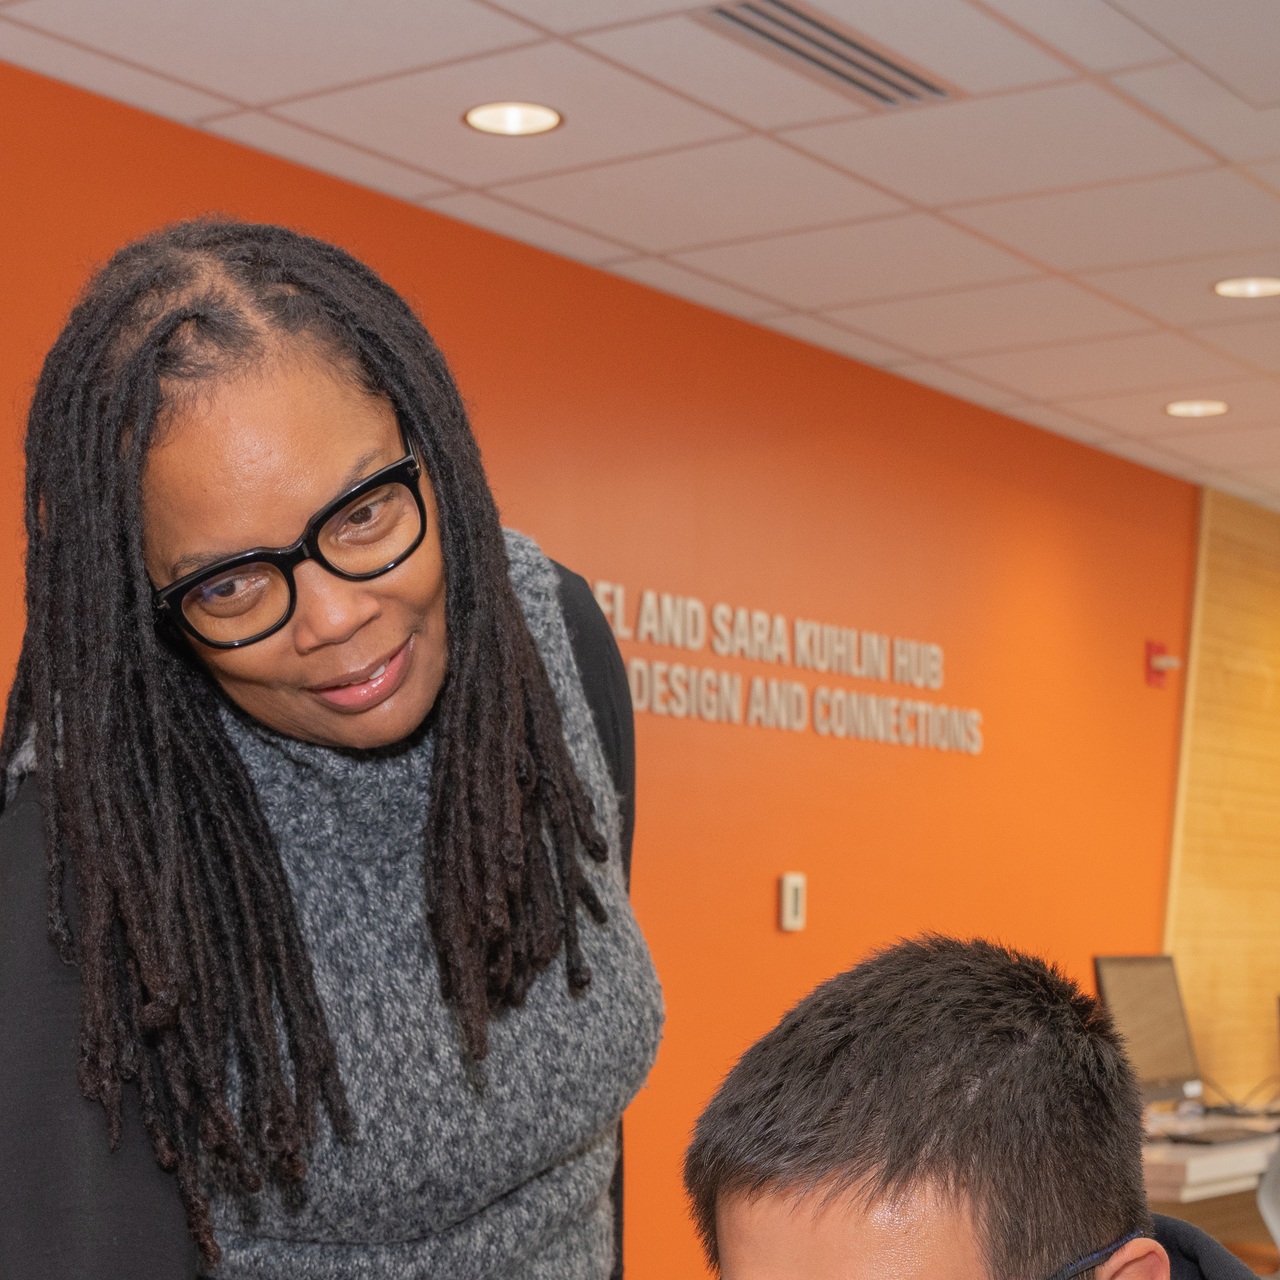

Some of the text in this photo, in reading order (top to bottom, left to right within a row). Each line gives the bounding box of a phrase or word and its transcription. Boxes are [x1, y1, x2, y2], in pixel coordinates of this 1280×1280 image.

[637, 588, 707, 652] AND
[712, 602, 790, 666] SARA
[793, 617, 888, 683] KUHLIN
[892, 636, 944, 690] HUB
[628, 657, 983, 755] DESIGN AND CONNECTIONS
